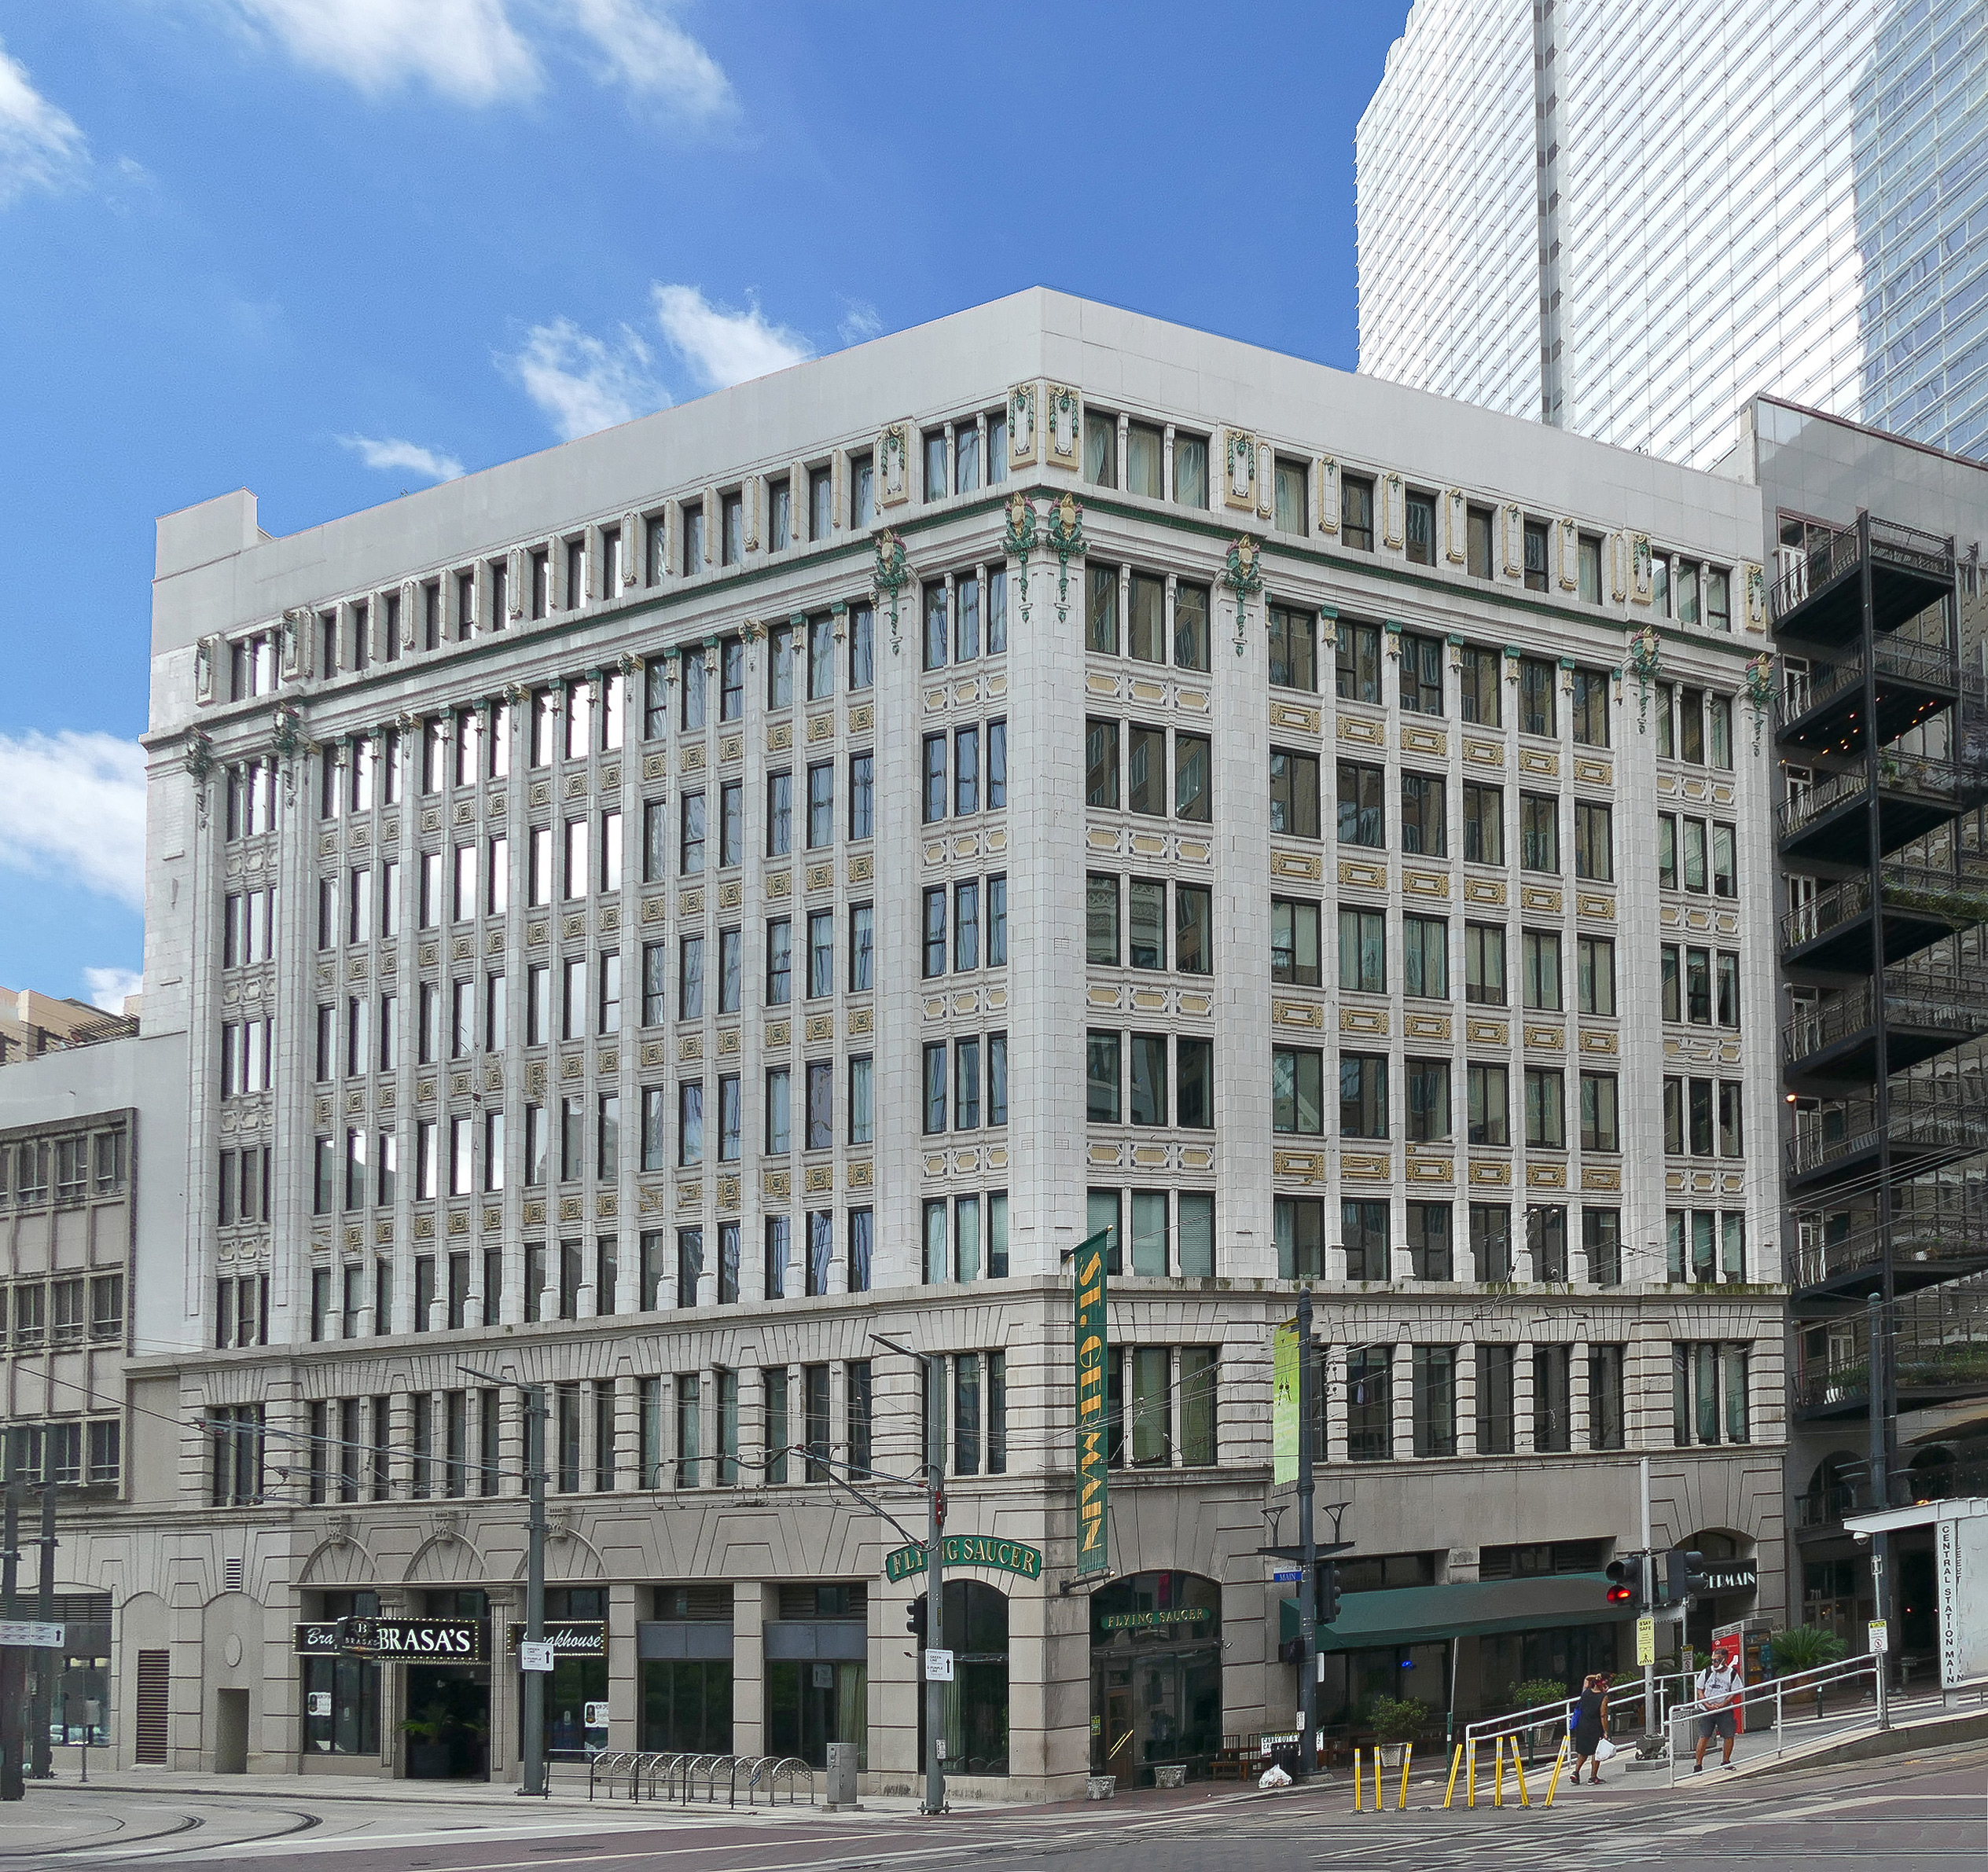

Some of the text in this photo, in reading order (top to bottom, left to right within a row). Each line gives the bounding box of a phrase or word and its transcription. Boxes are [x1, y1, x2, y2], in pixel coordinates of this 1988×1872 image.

[1079, 1251, 1102, 1552] ST. GERMAIN
[892, 1538, 1035, 1576] FLYG SAUCER
[1108, 1608, 1203, 1628] FLYING SAUCER
[1942, 1525, 1954, 1683] CENTRAL STATION MAIN
[379, 1628, 471, 1652] BRASA'S
